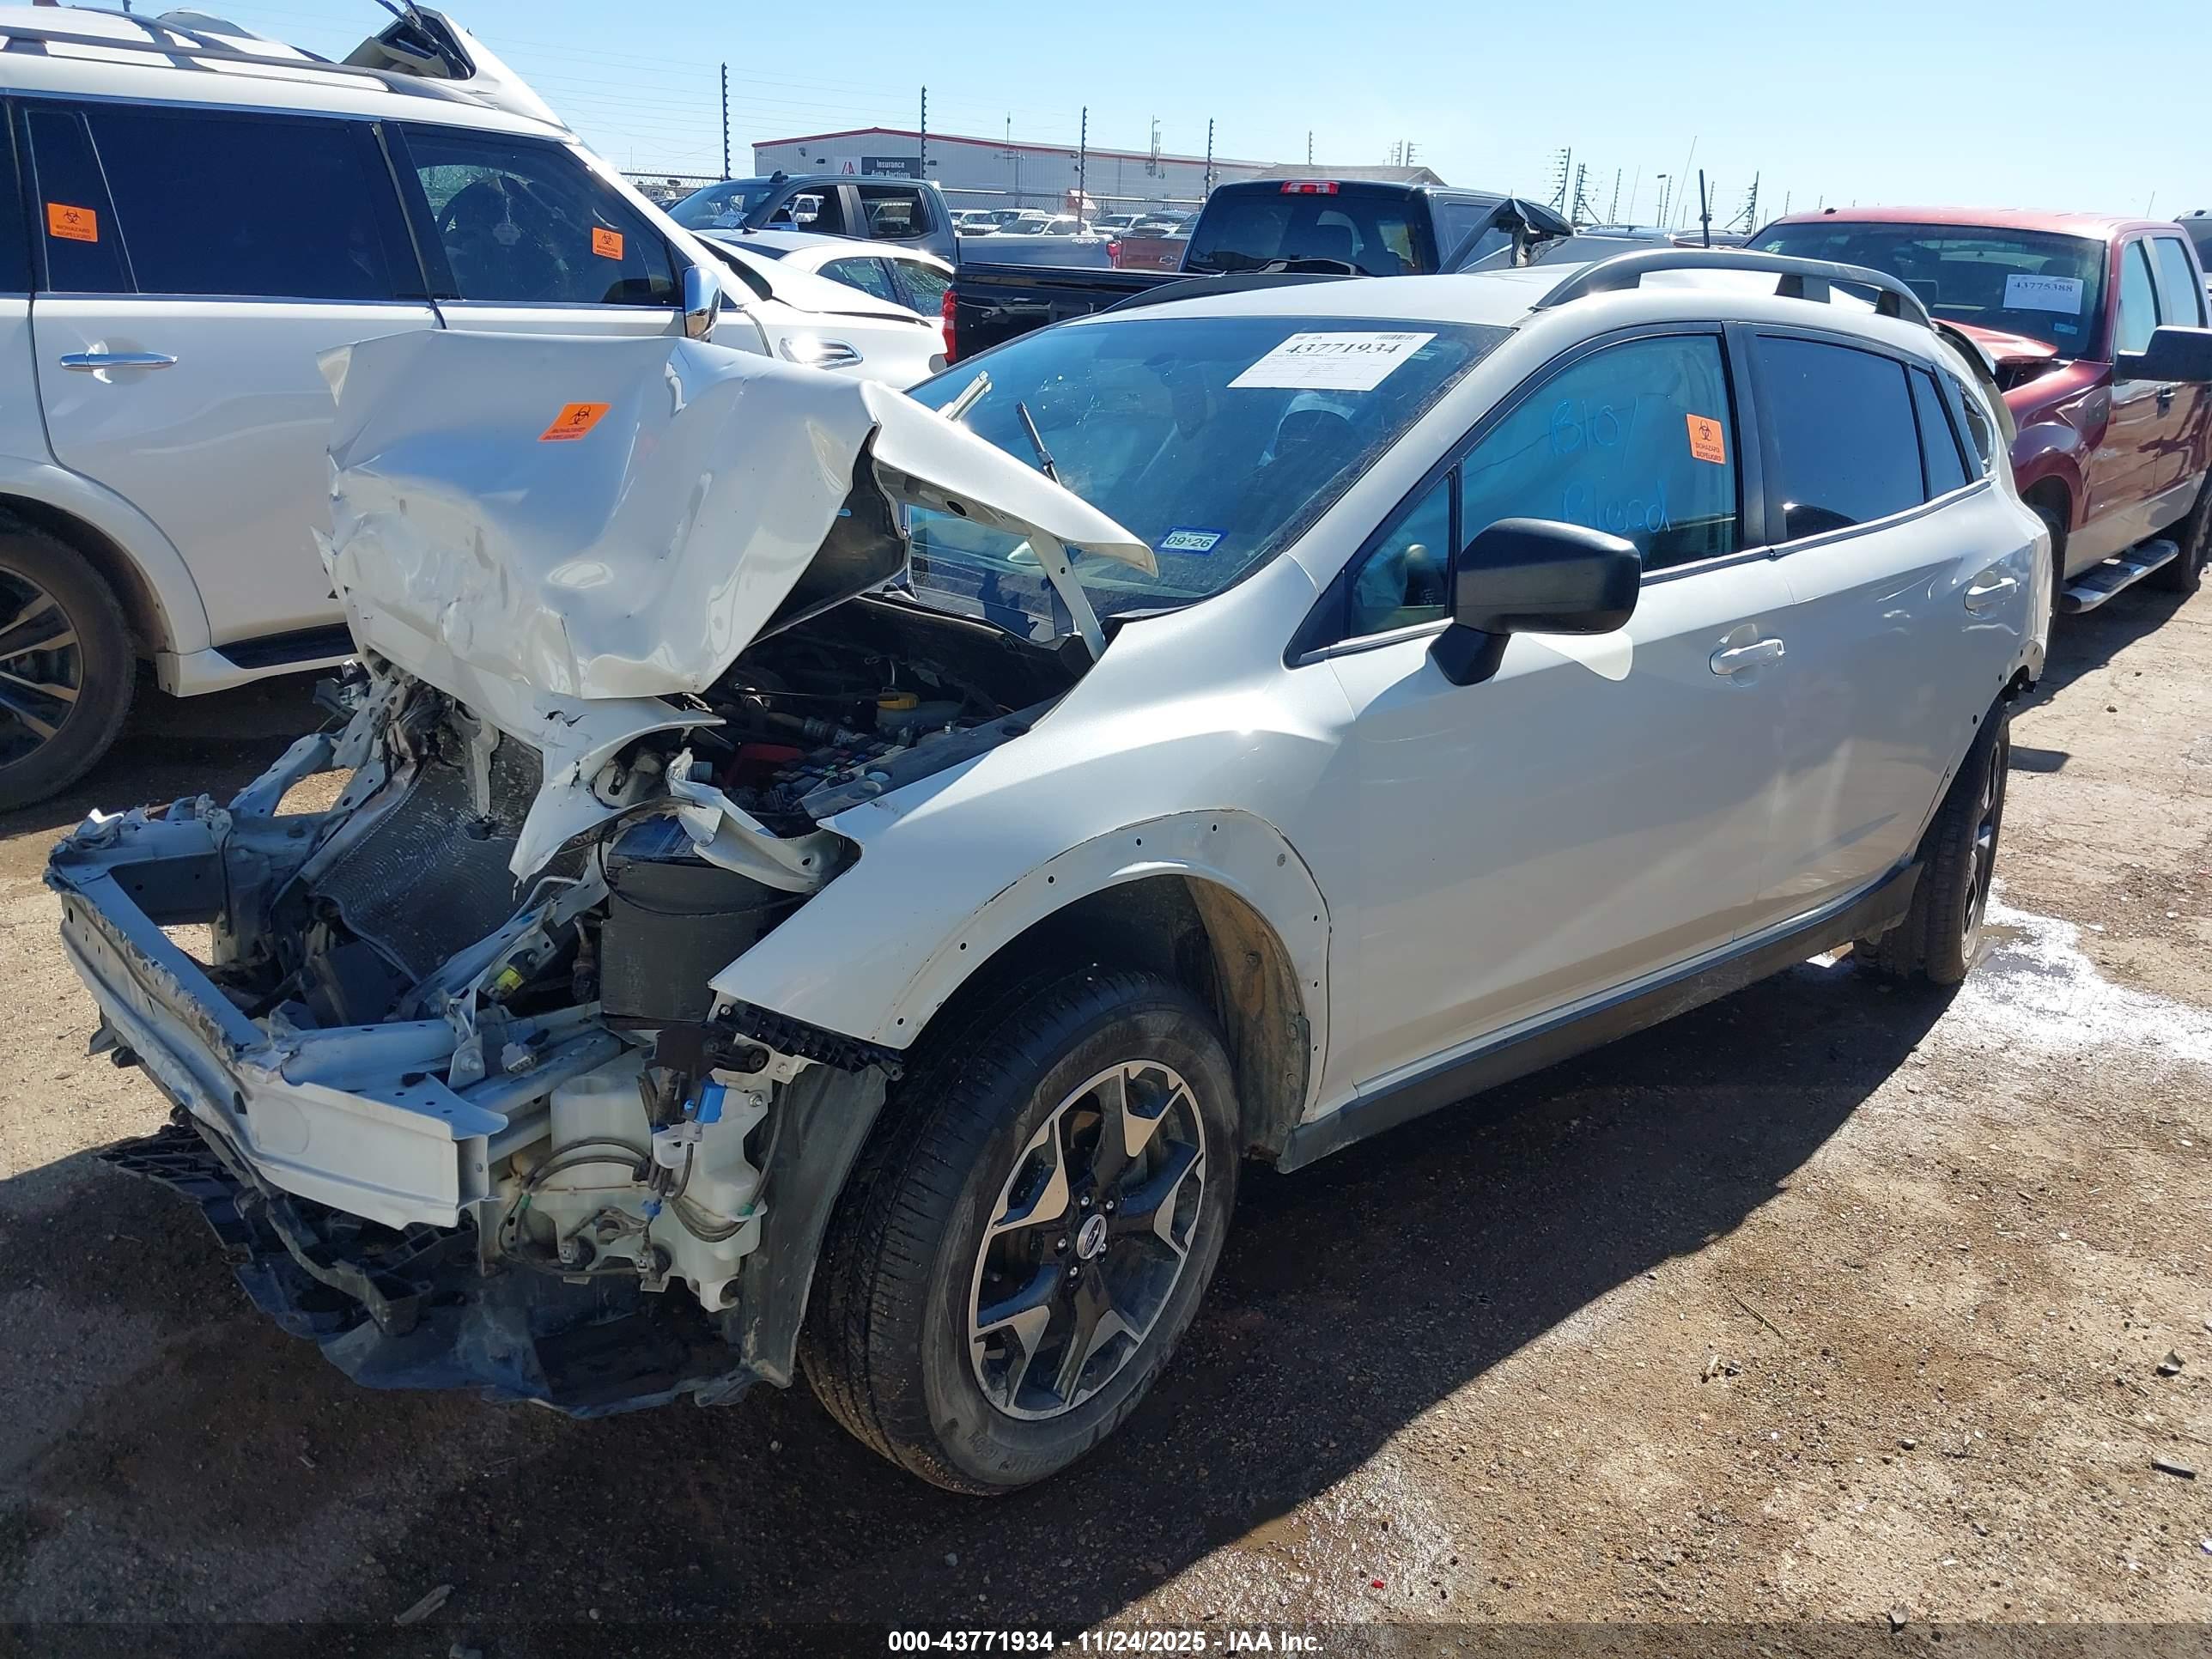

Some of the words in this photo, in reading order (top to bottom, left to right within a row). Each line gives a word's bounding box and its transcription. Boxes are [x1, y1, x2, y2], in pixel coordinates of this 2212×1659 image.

[876, 159, 905, 169] Insurance
[2014, 281, 2074, 293] 43775388
[1285, 343, 1402, 354] 43771934
